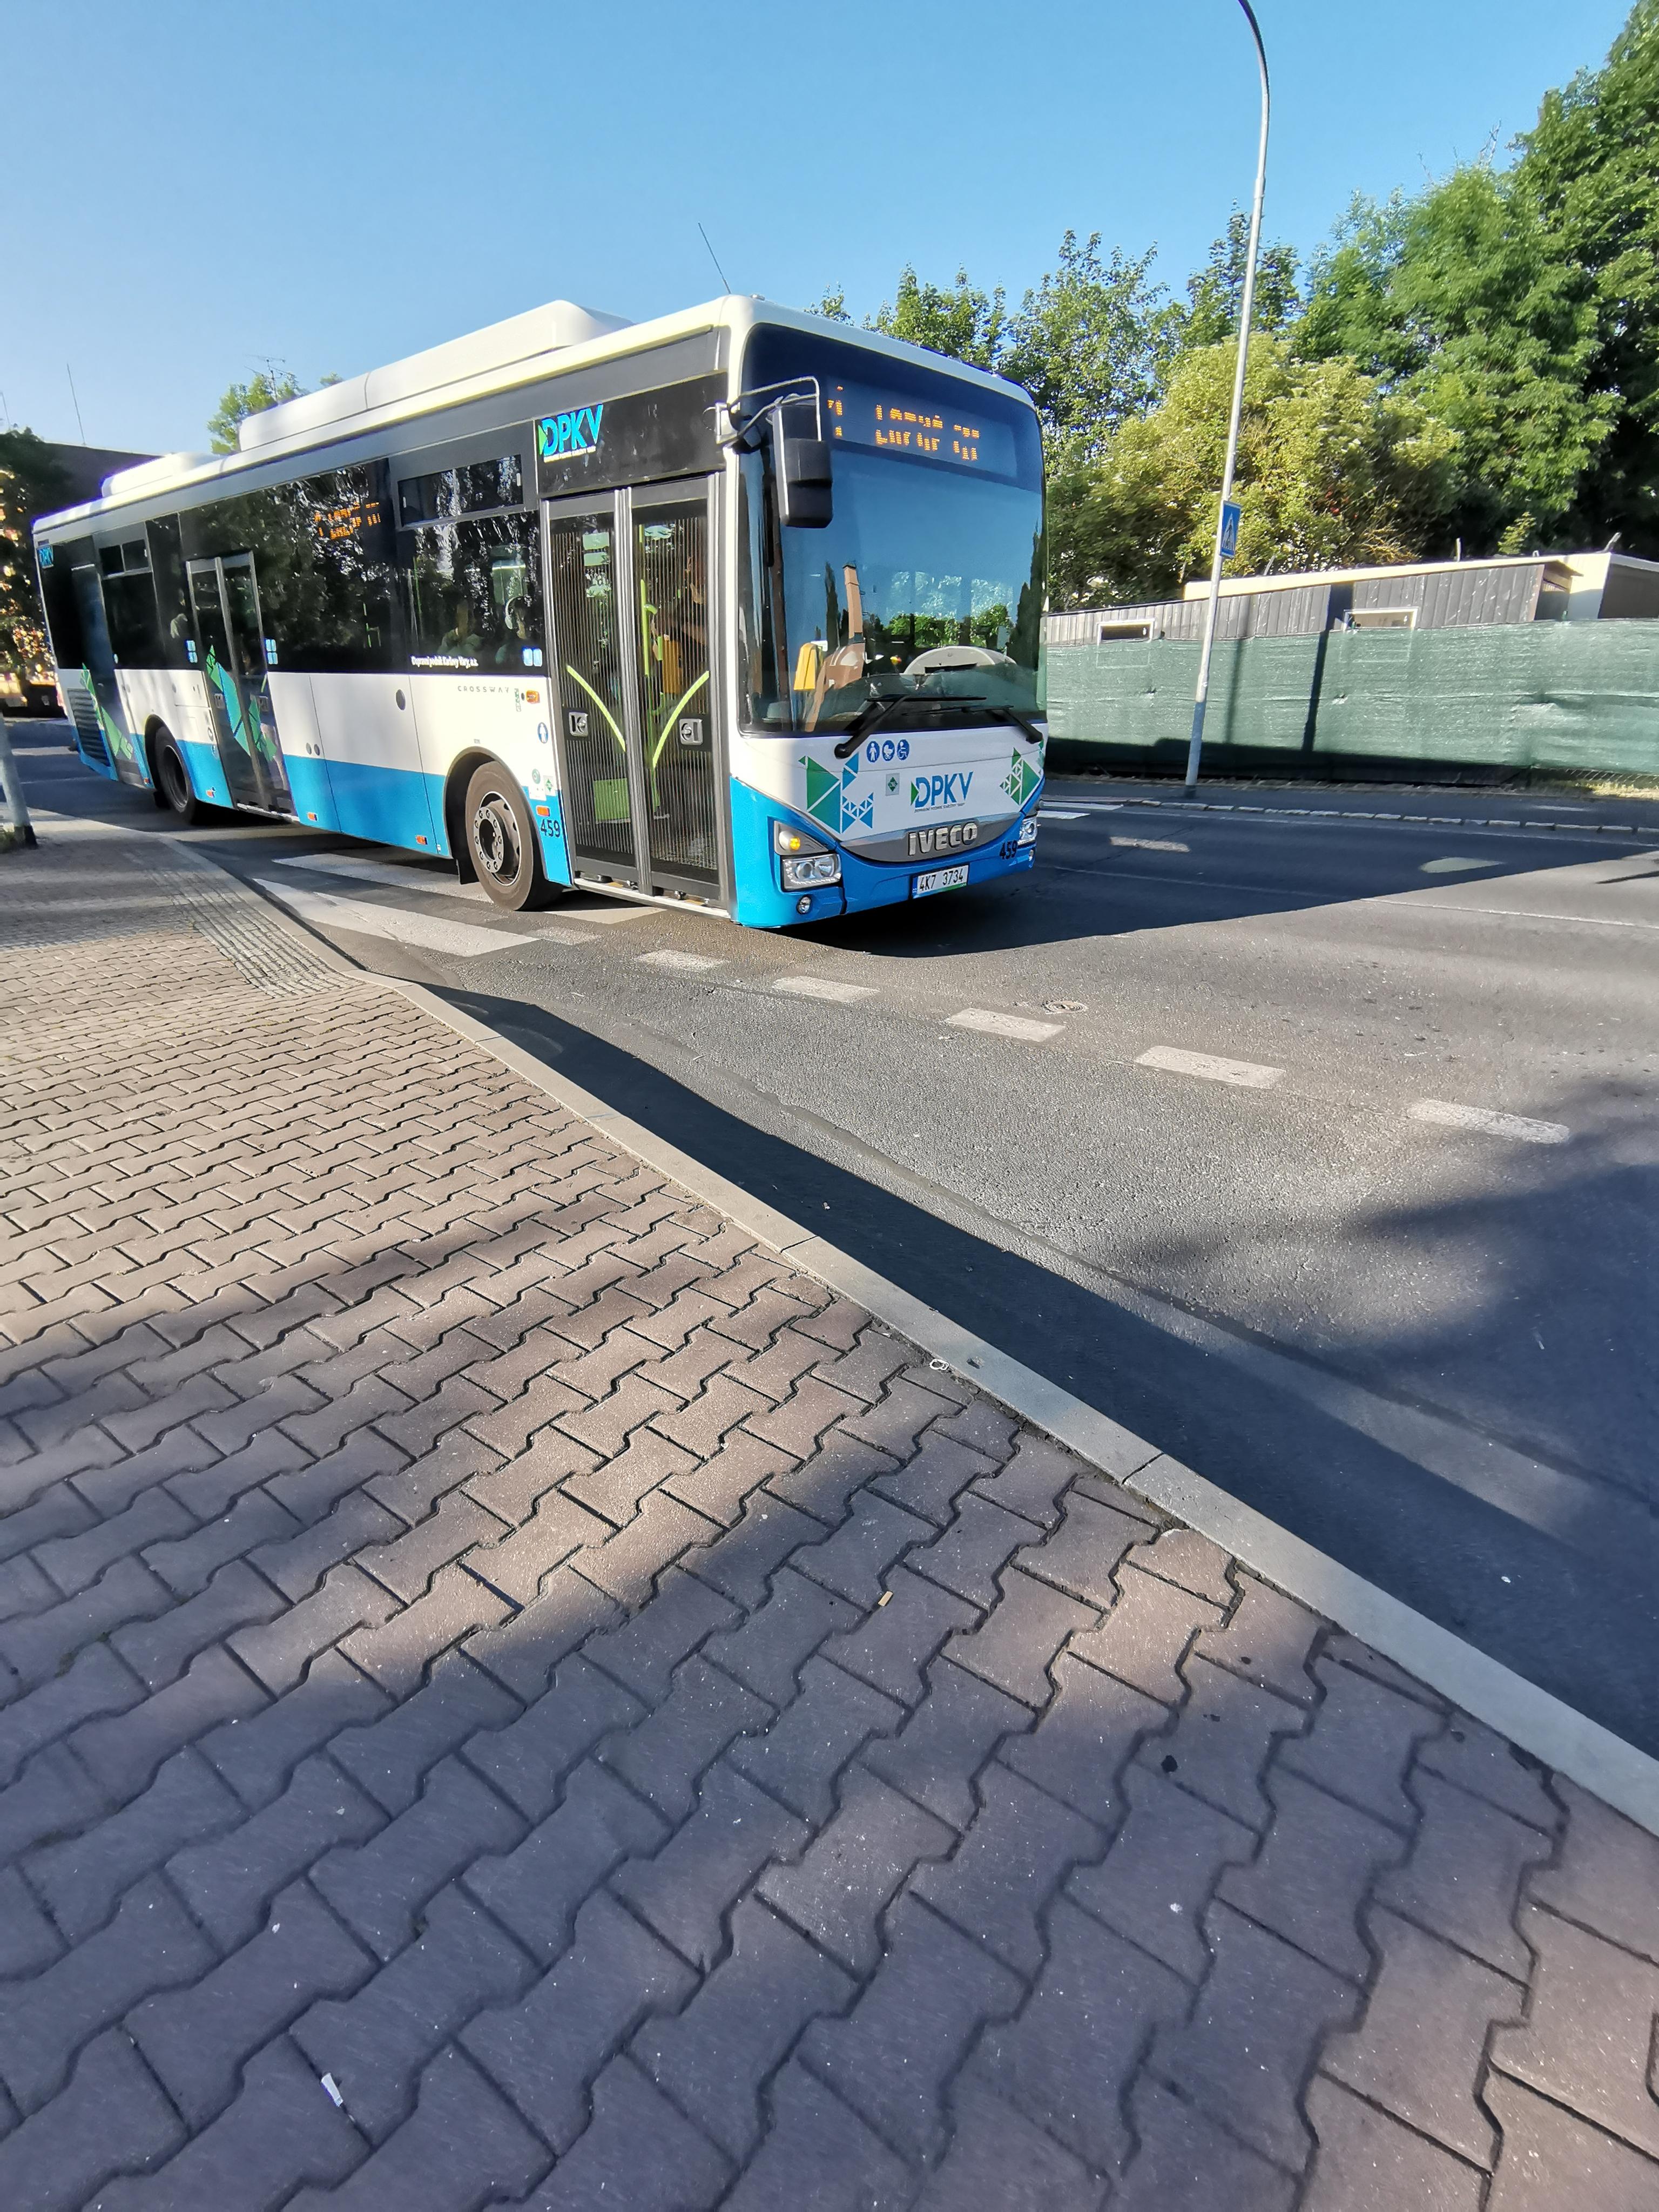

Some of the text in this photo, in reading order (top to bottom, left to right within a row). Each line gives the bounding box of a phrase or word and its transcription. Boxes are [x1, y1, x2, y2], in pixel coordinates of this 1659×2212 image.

[542, 404, 603, 456] DPKV
[915, 771, 974, 808] DPKV
[541, 819, 561, 838] 459
[908, 822, 978, 856] IVECO
[1000, 840, 1018, 860] 459
[919, 868, 963, 891] 4K7 3734
